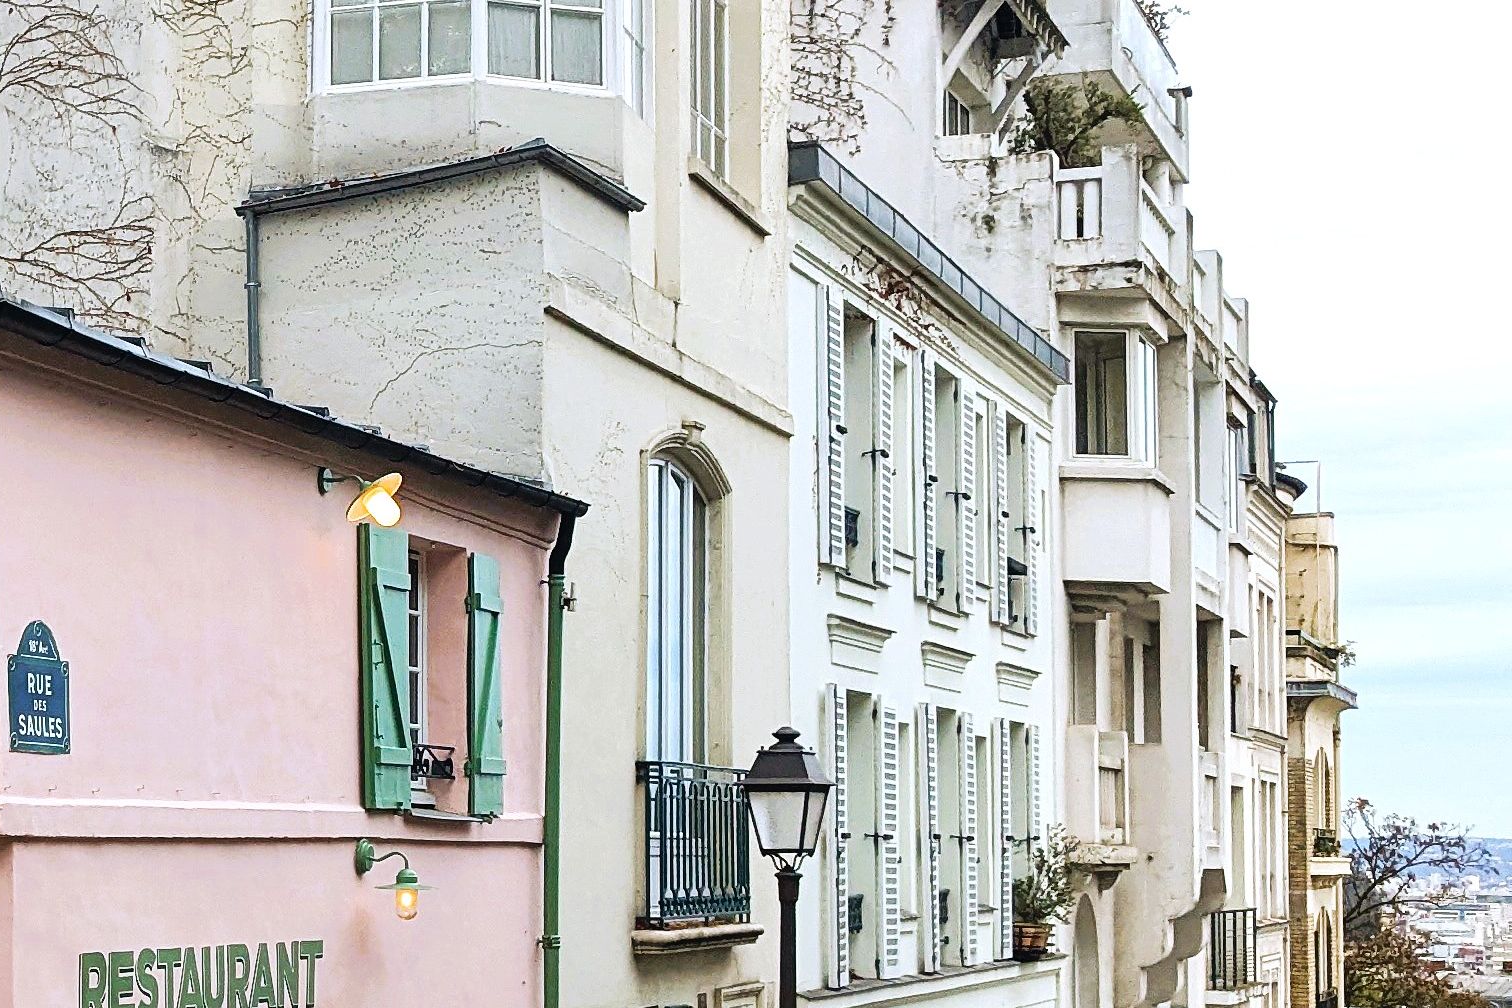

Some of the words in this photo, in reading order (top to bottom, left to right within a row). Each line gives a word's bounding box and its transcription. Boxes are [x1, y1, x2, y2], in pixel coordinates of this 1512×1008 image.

[27, 672, 52, 696] RUE
[33, 700, 47, 712] DES
[18, 714, 63, 739] SAULES
